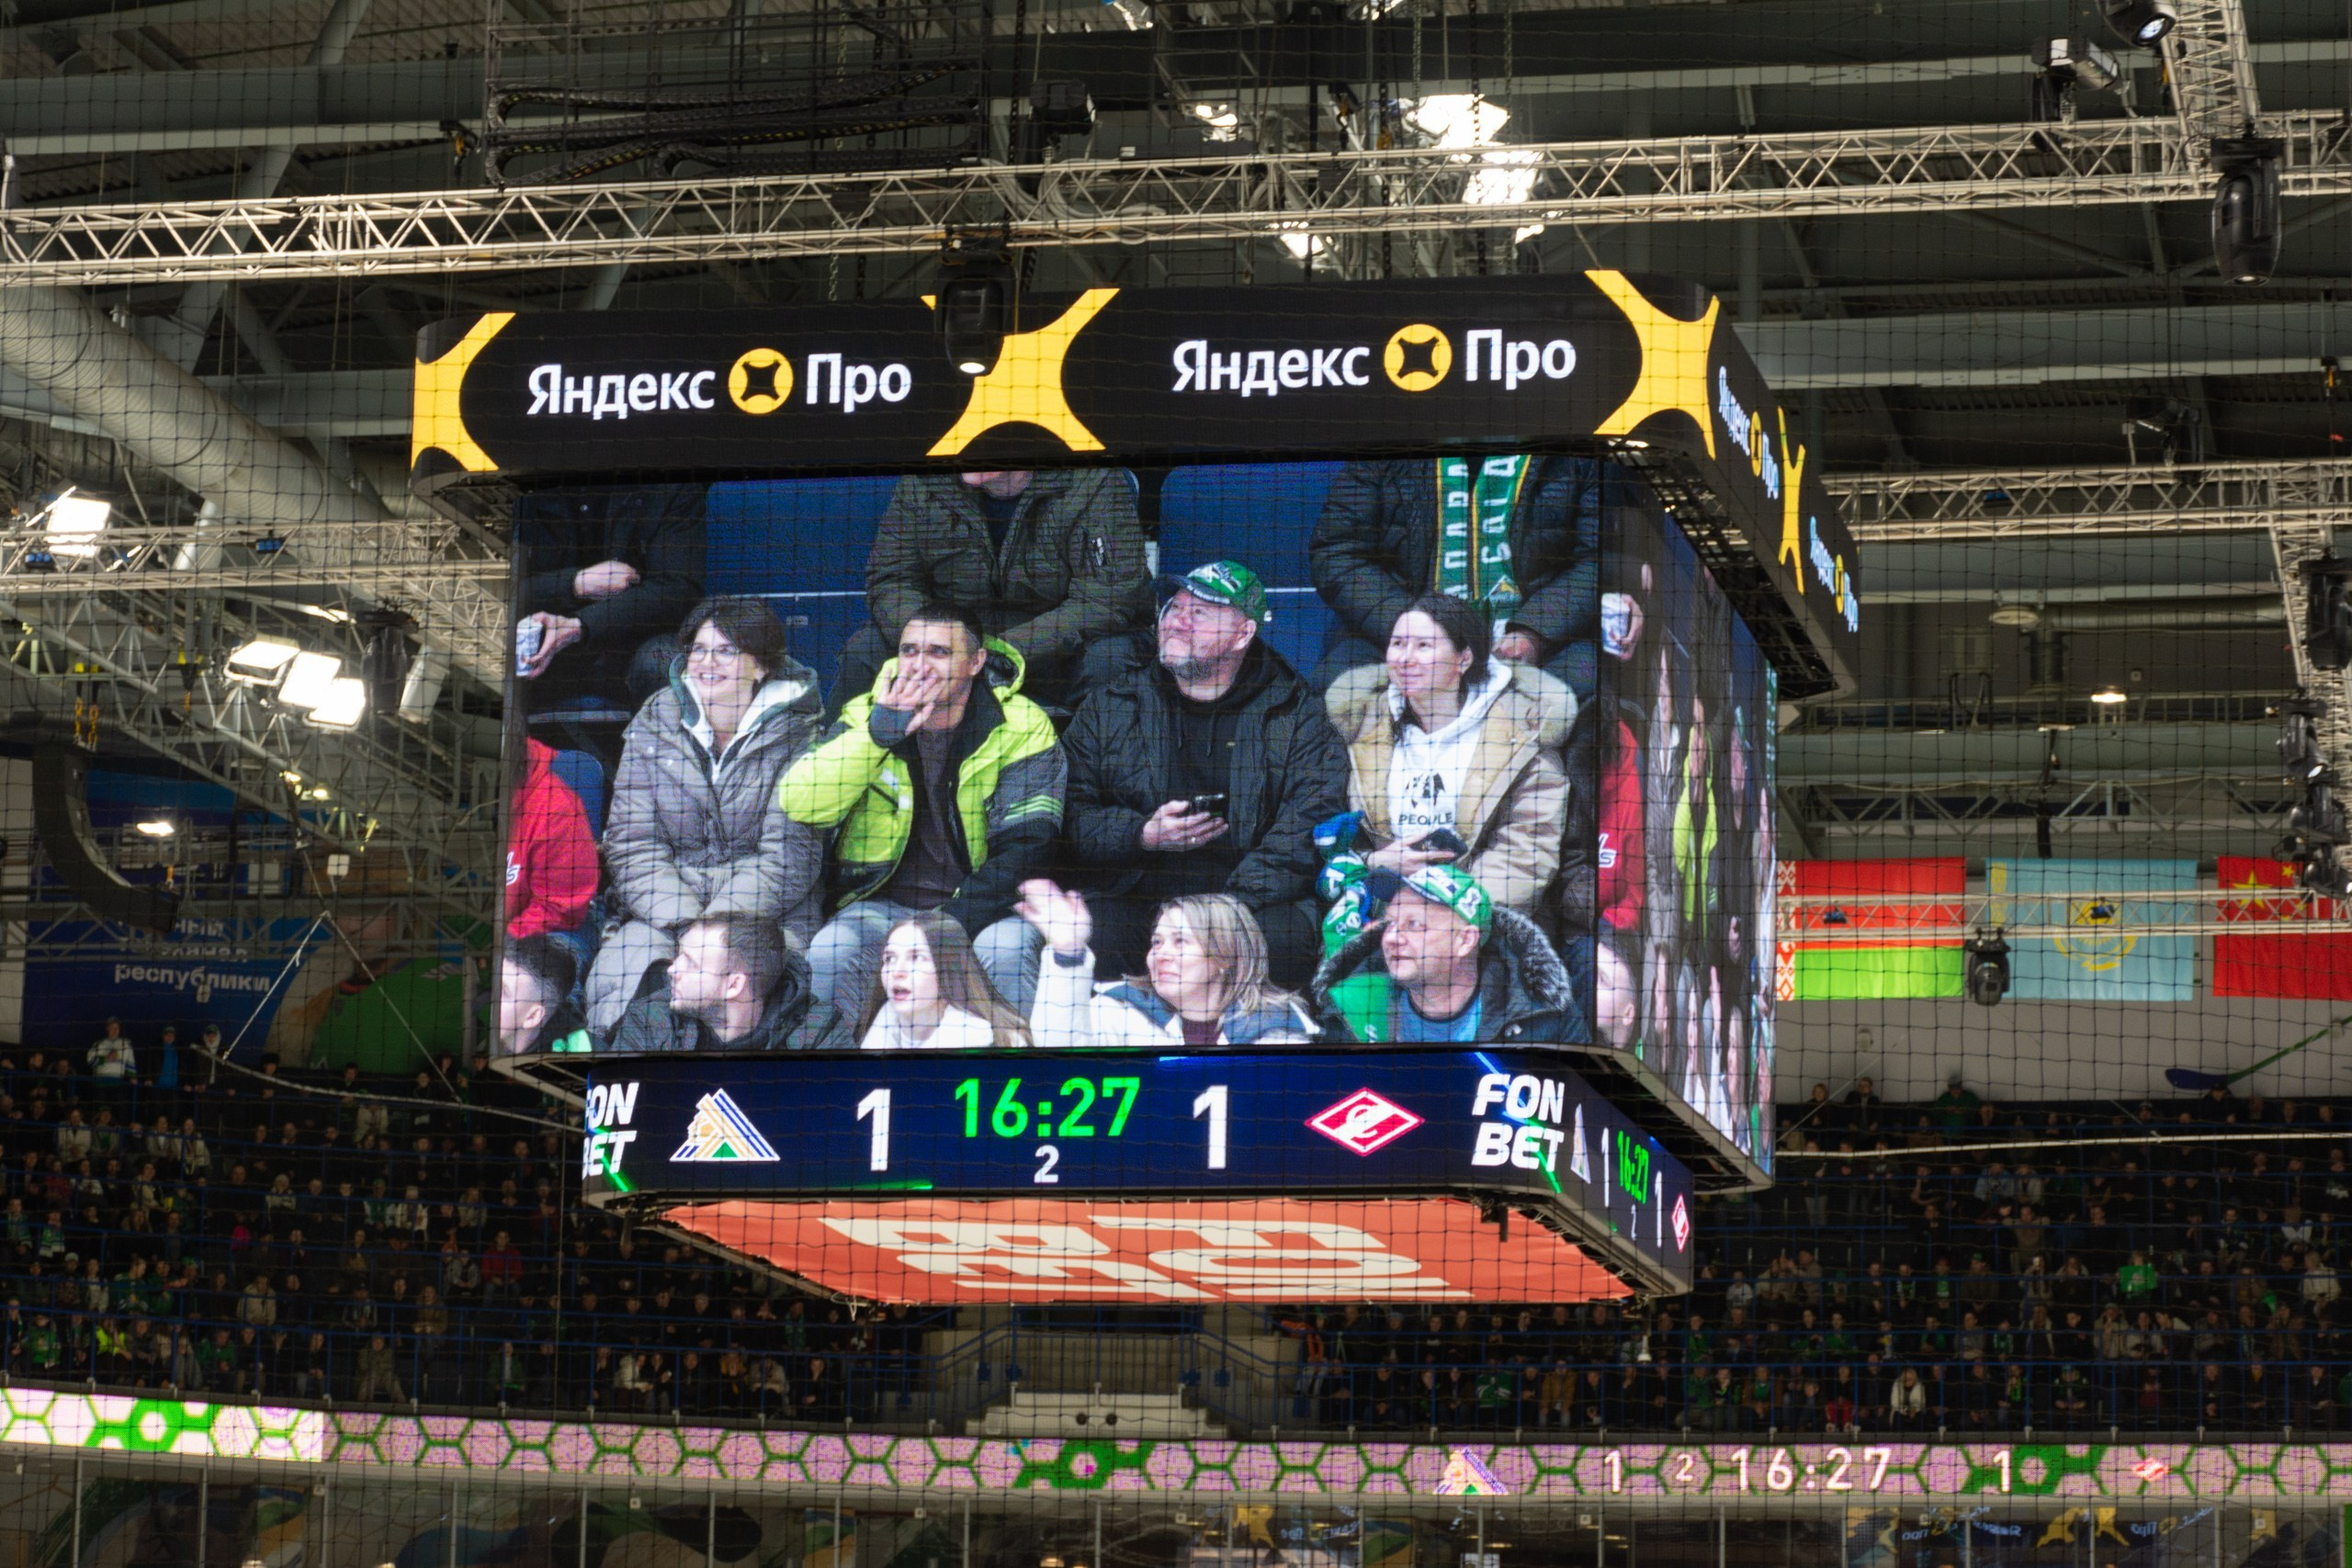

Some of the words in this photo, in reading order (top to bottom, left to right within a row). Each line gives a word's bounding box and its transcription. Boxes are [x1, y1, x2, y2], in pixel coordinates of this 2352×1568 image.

[527, 365, 716, 421] Яндекс
[807, 353, 911, 413] Про
[1171, 340, 1370, 397] Яндекс
[1465, 330, 1577, 389] Про
[1762, 431, 1779, 500] Про
[115, 963, 269, 992] республики
[955, 1077, 1140, 1137] 16:27
[1472, 1074, 1565, 1123] FON
[856, 1089, 891, 1172] 1
[1193, 1085, 1228, 1169] 1
[1471, 1122, 1565, 1172] BET
[1034, 1145, 1059, 1183] 2
[1617, 1130, 1649, 1205] 16:27
[1604, 1450, 1622, 1493] 1
[1675, 1453, 1693, 1482] 2
[1731, 1447, 1892, 1492] 16:27
[1994, 1450, 2012, 1493] 1
